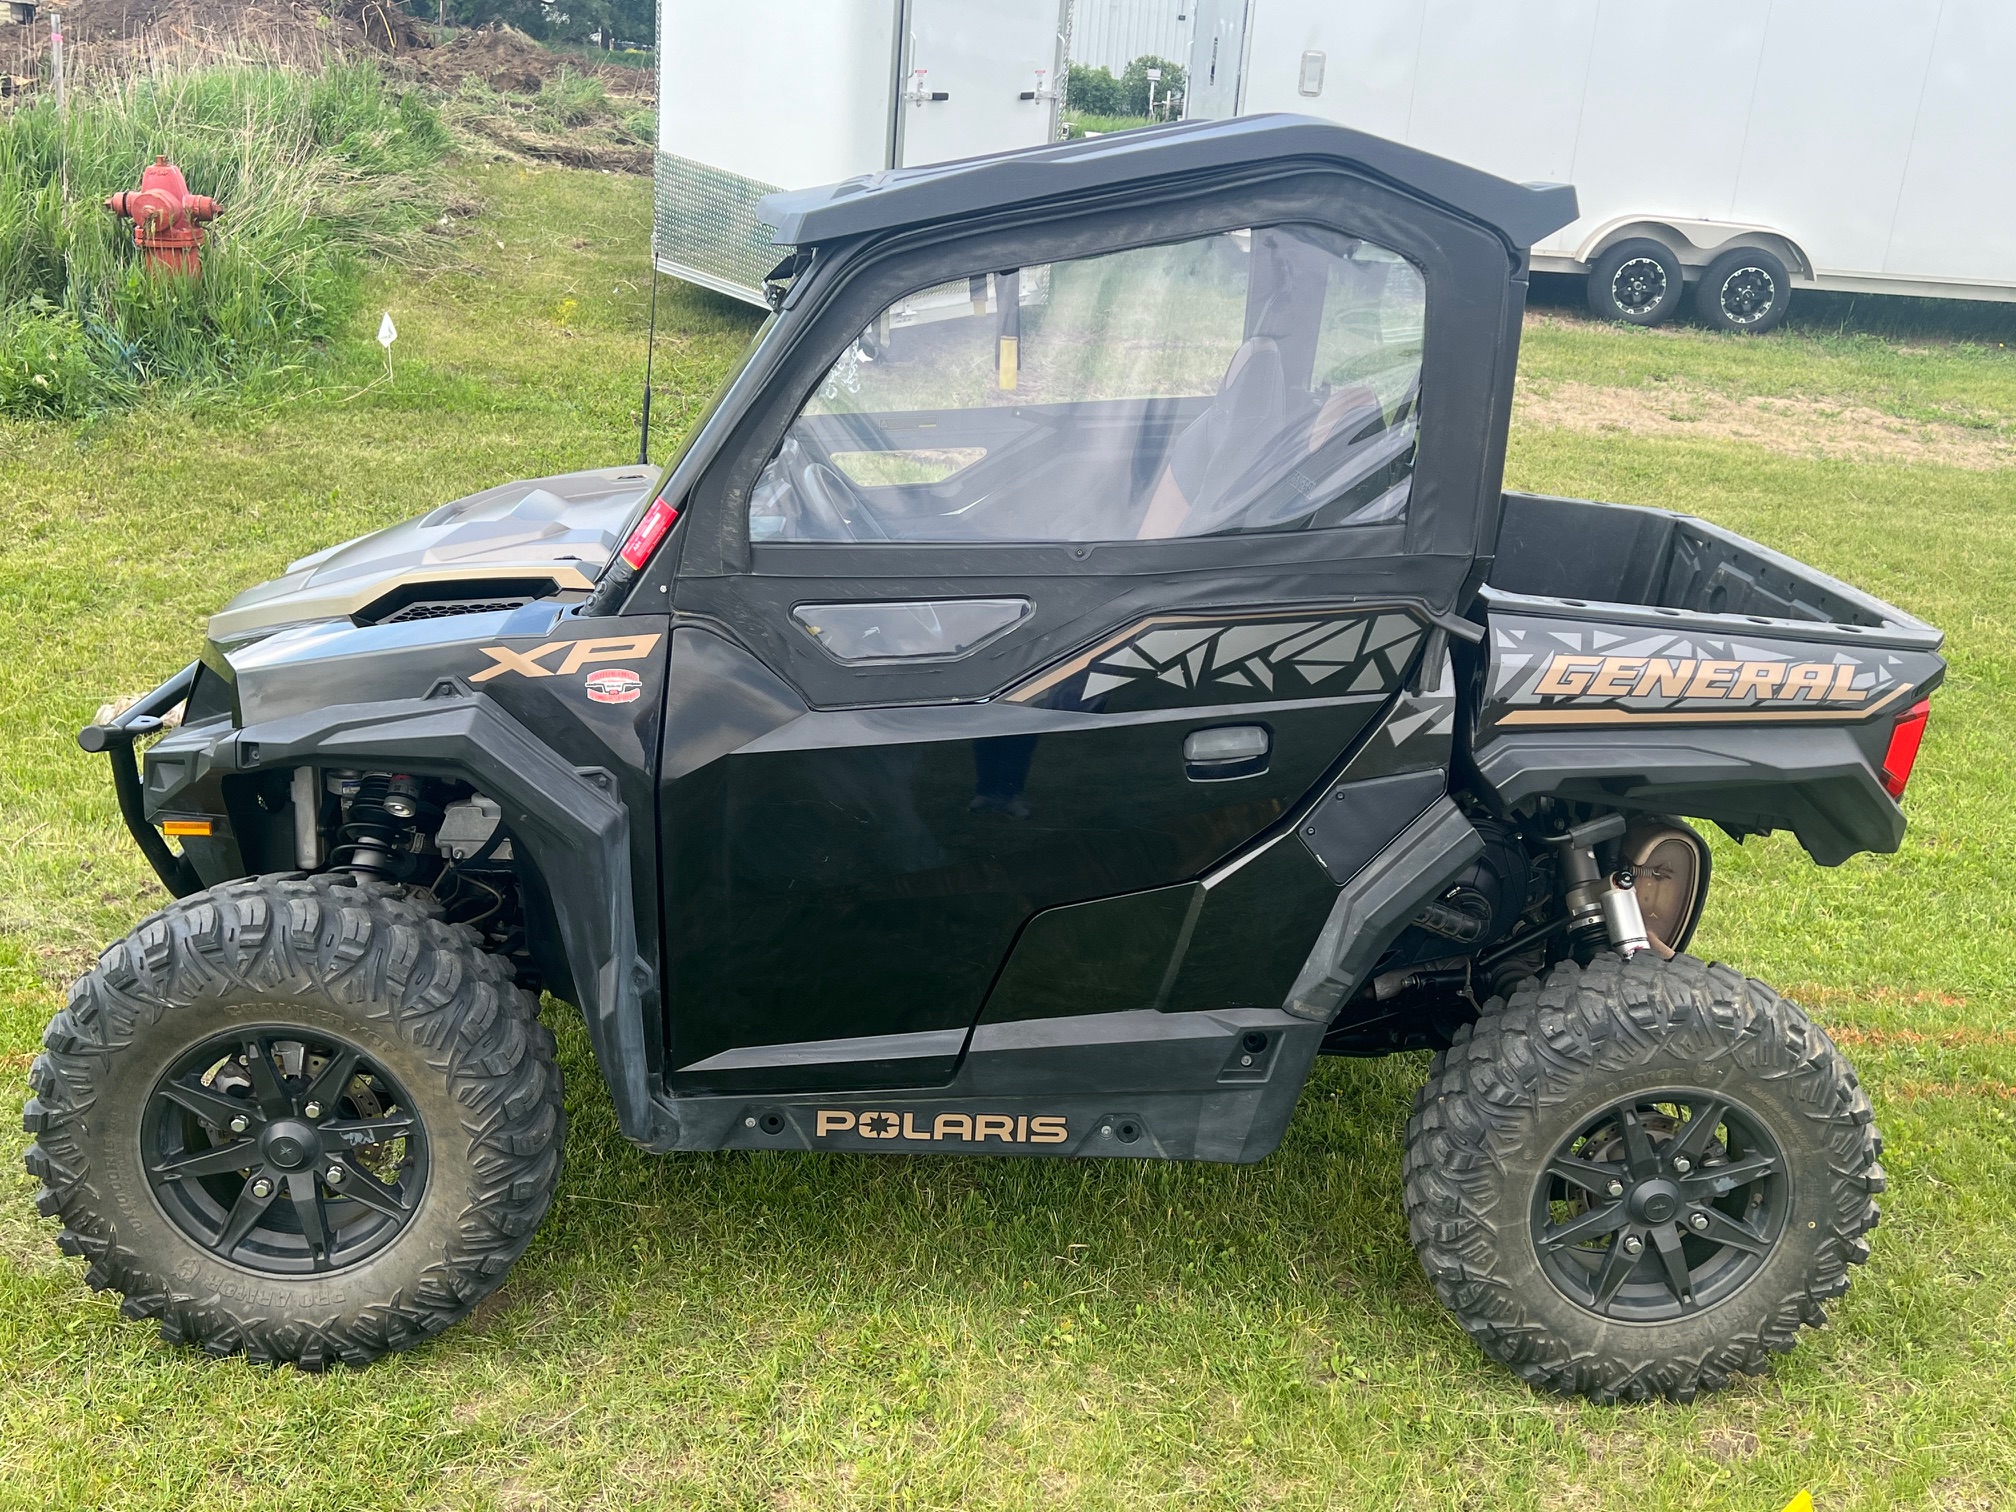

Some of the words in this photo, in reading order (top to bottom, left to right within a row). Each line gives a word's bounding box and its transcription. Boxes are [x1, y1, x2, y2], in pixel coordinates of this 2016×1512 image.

[468, 633, 662, 683] XP
[1533, 653, 1874, 702] GENERAL
[223, 1002, 346, 1027] CRAWLER
[815, 1109, 1069, 1144] POLARIS
[204, 1273, 292, 1309] ARMOR
[298, 1288, 347, 1309] PRO
